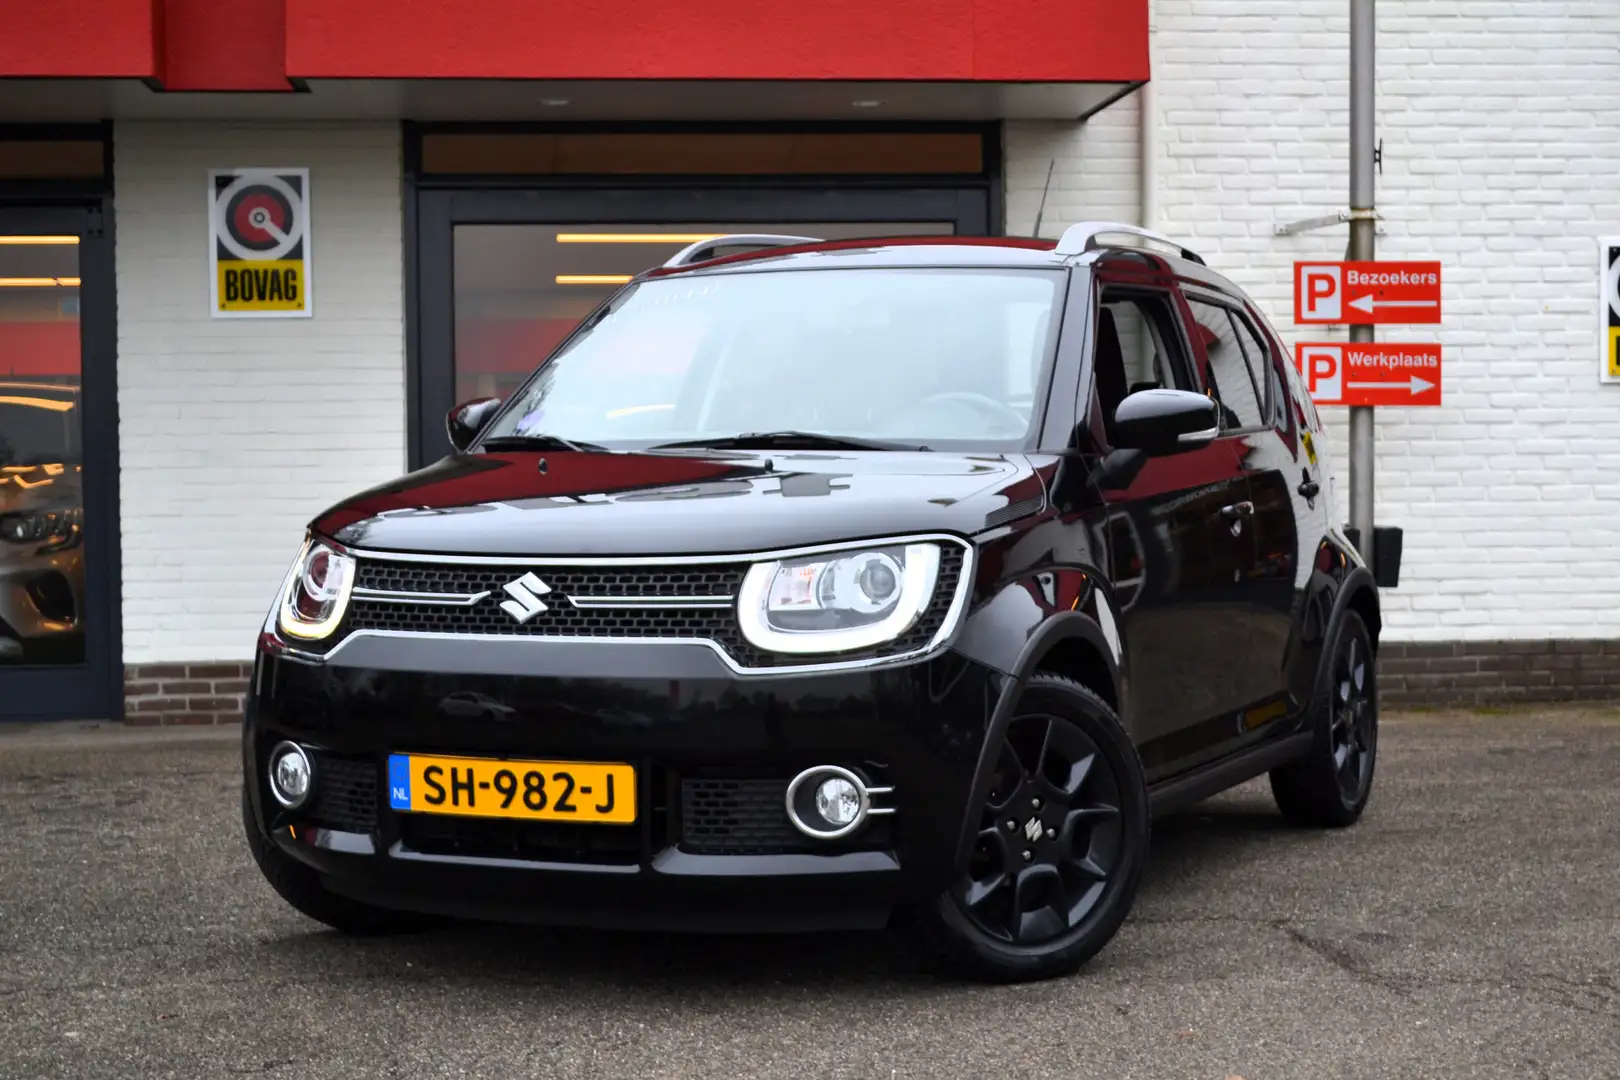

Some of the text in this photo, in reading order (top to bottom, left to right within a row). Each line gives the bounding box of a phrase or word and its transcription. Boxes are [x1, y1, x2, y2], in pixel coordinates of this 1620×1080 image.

[225, 268, 297, 302] BOVAG
[1307, 270, 1437, 312] P Bezoekers
[1308, 351, 1438, 392] P Werkplaats
[393, 787, 408, 800] NL
[423, 765, 615, 814] SH-982-J
